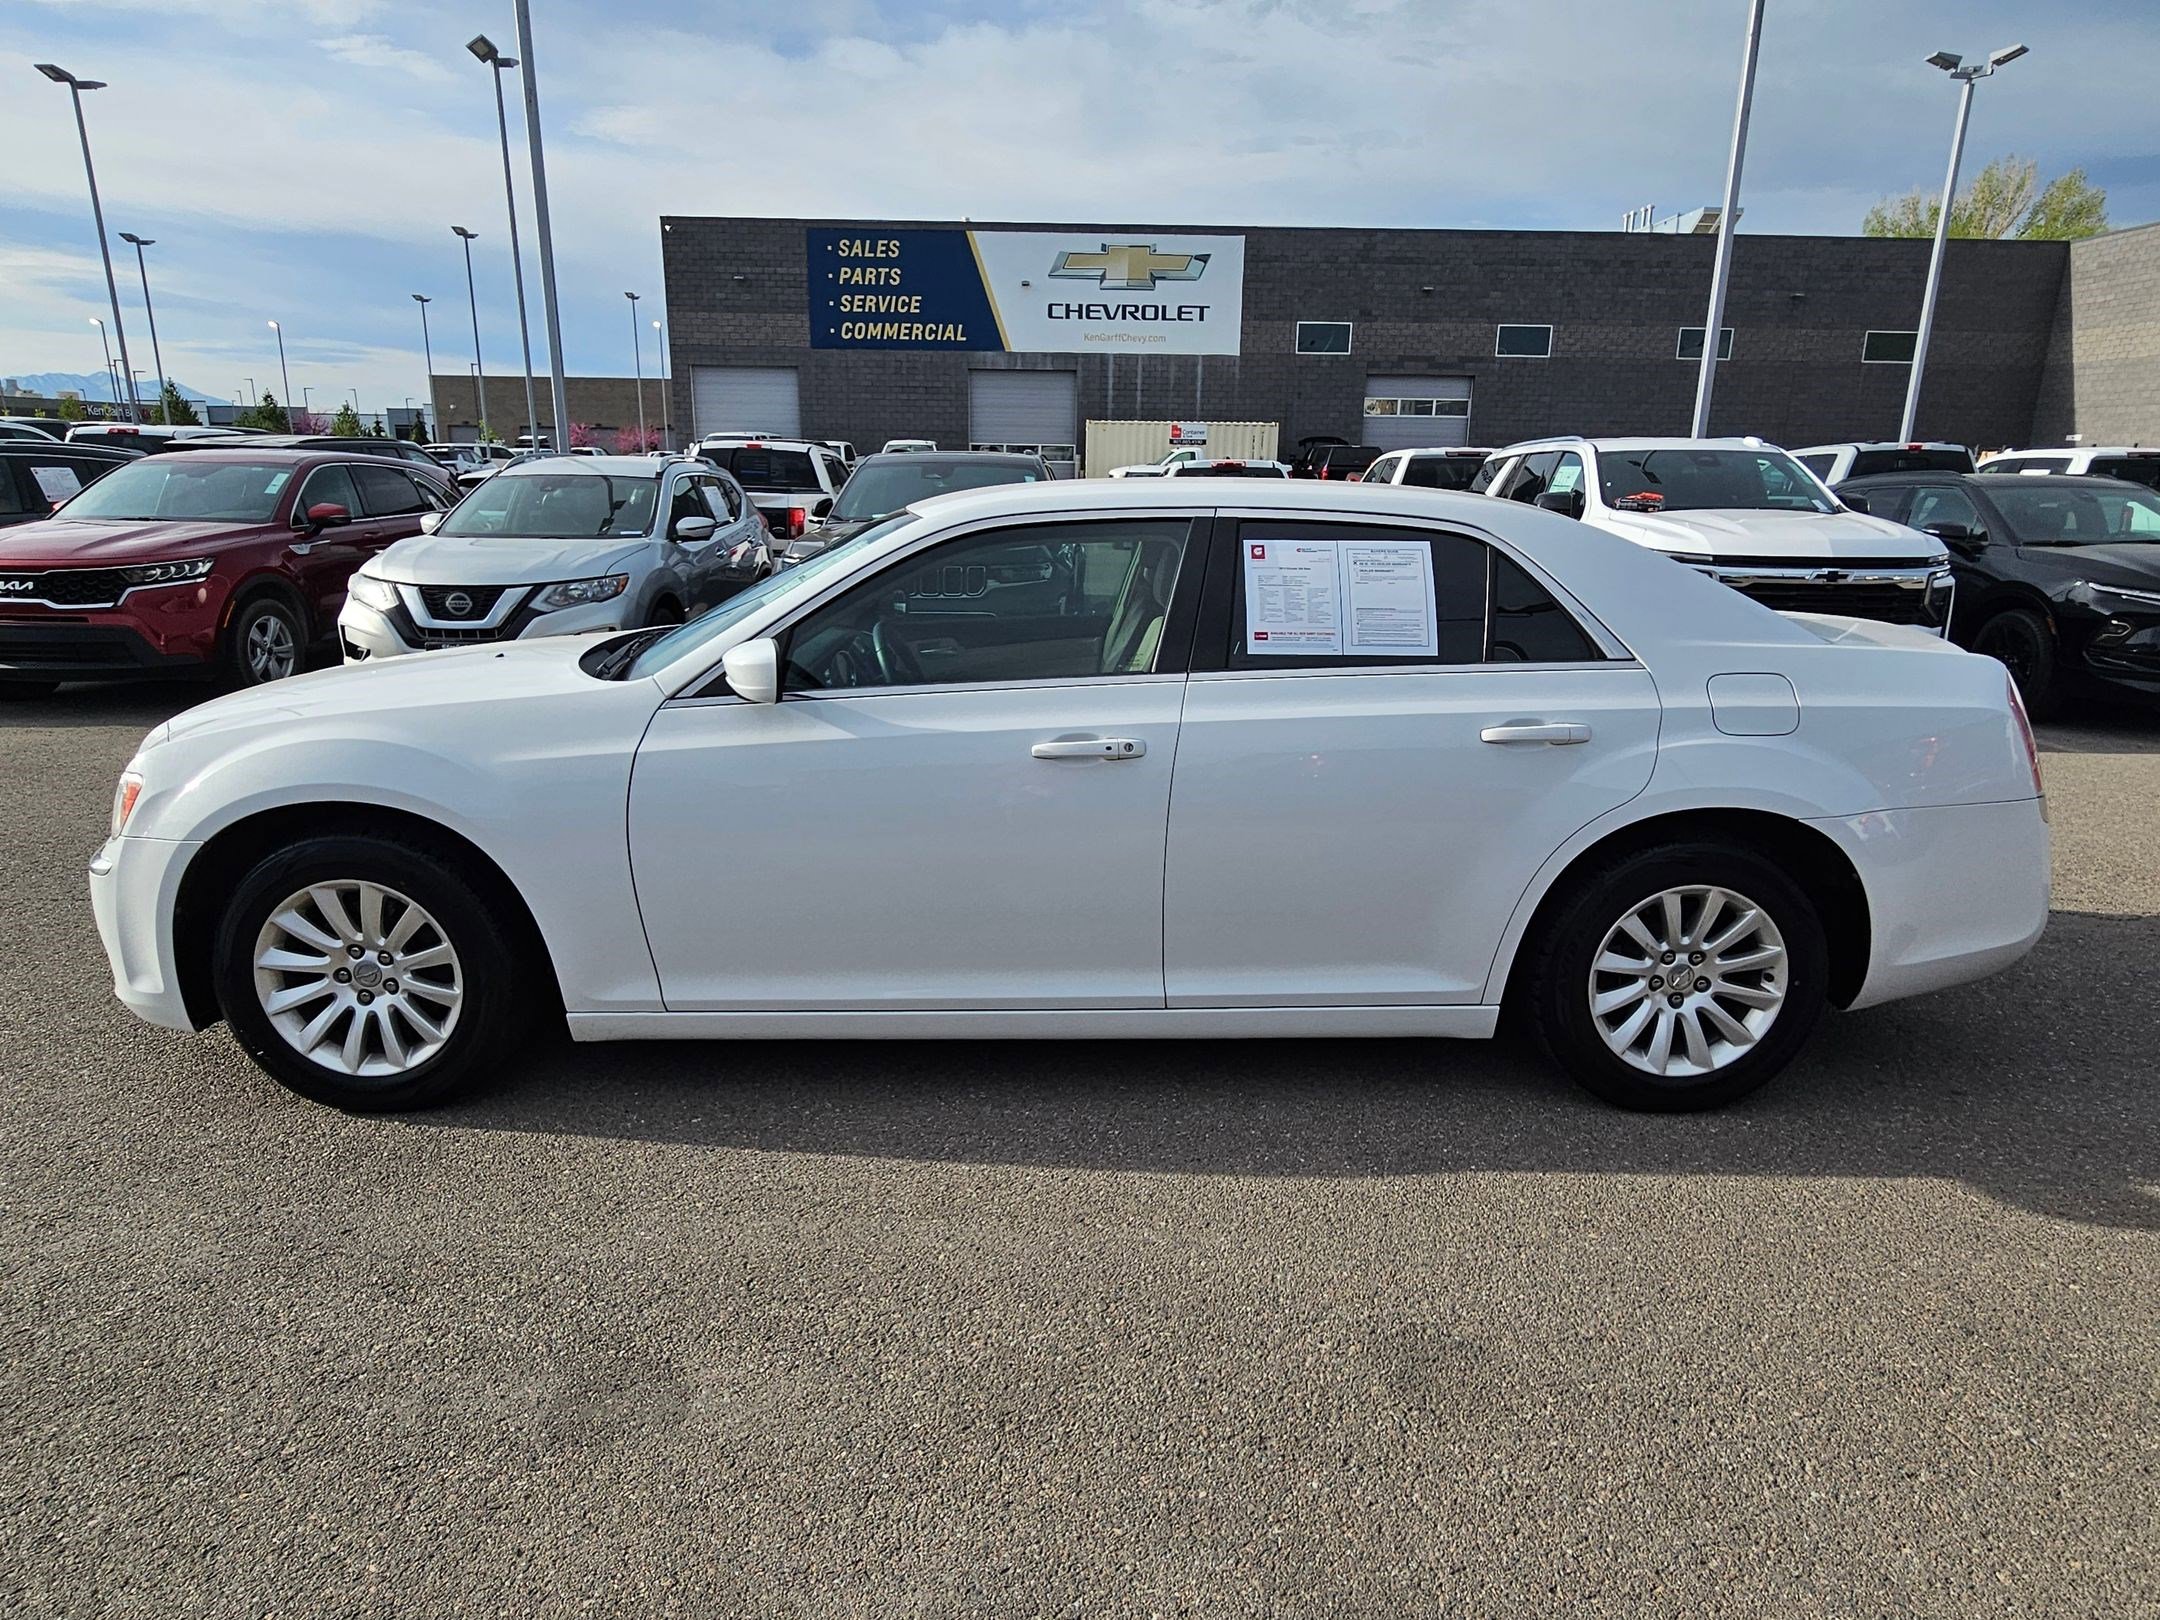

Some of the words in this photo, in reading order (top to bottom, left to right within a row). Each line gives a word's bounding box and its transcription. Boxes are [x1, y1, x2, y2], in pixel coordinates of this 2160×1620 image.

[838, 239, 900, 258] SALES
[839, 267, 902, 285] PARTS
[839, 294, 922, 313] SERVICE
[1047, 303, 1211, 322] CHEVROLET
[841, 322, 967, 341] COMMERCIAL
[1083, 333, 1166, 344] KenGarffChevy.com
